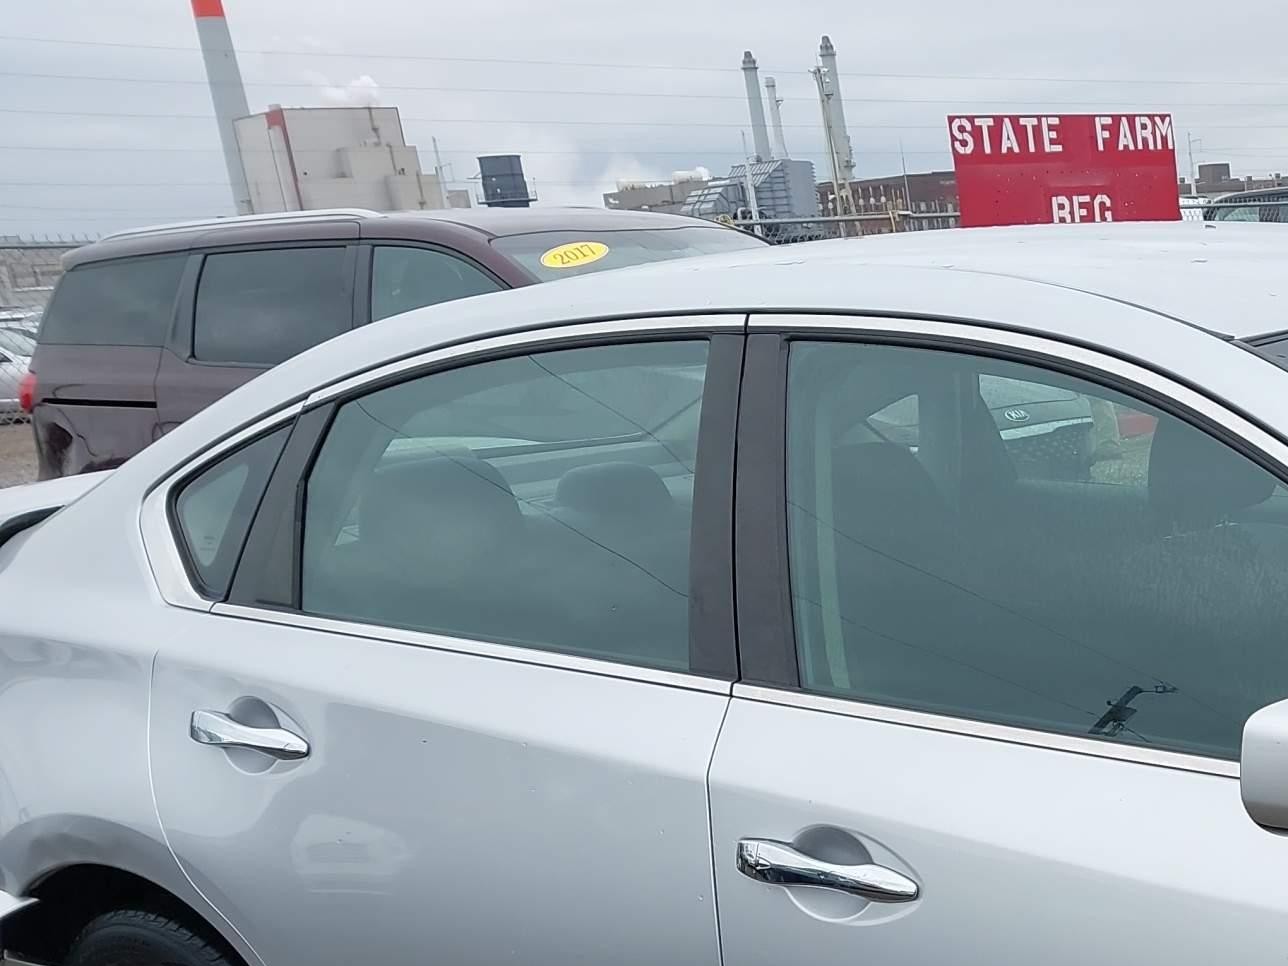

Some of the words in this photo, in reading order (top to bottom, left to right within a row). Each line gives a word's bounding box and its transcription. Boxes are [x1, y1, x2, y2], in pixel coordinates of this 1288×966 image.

[951, 117, 1063, 154] STATE
[1095, 116, 1174, 151] FARM
[554, 244, 596, 264] 2017
